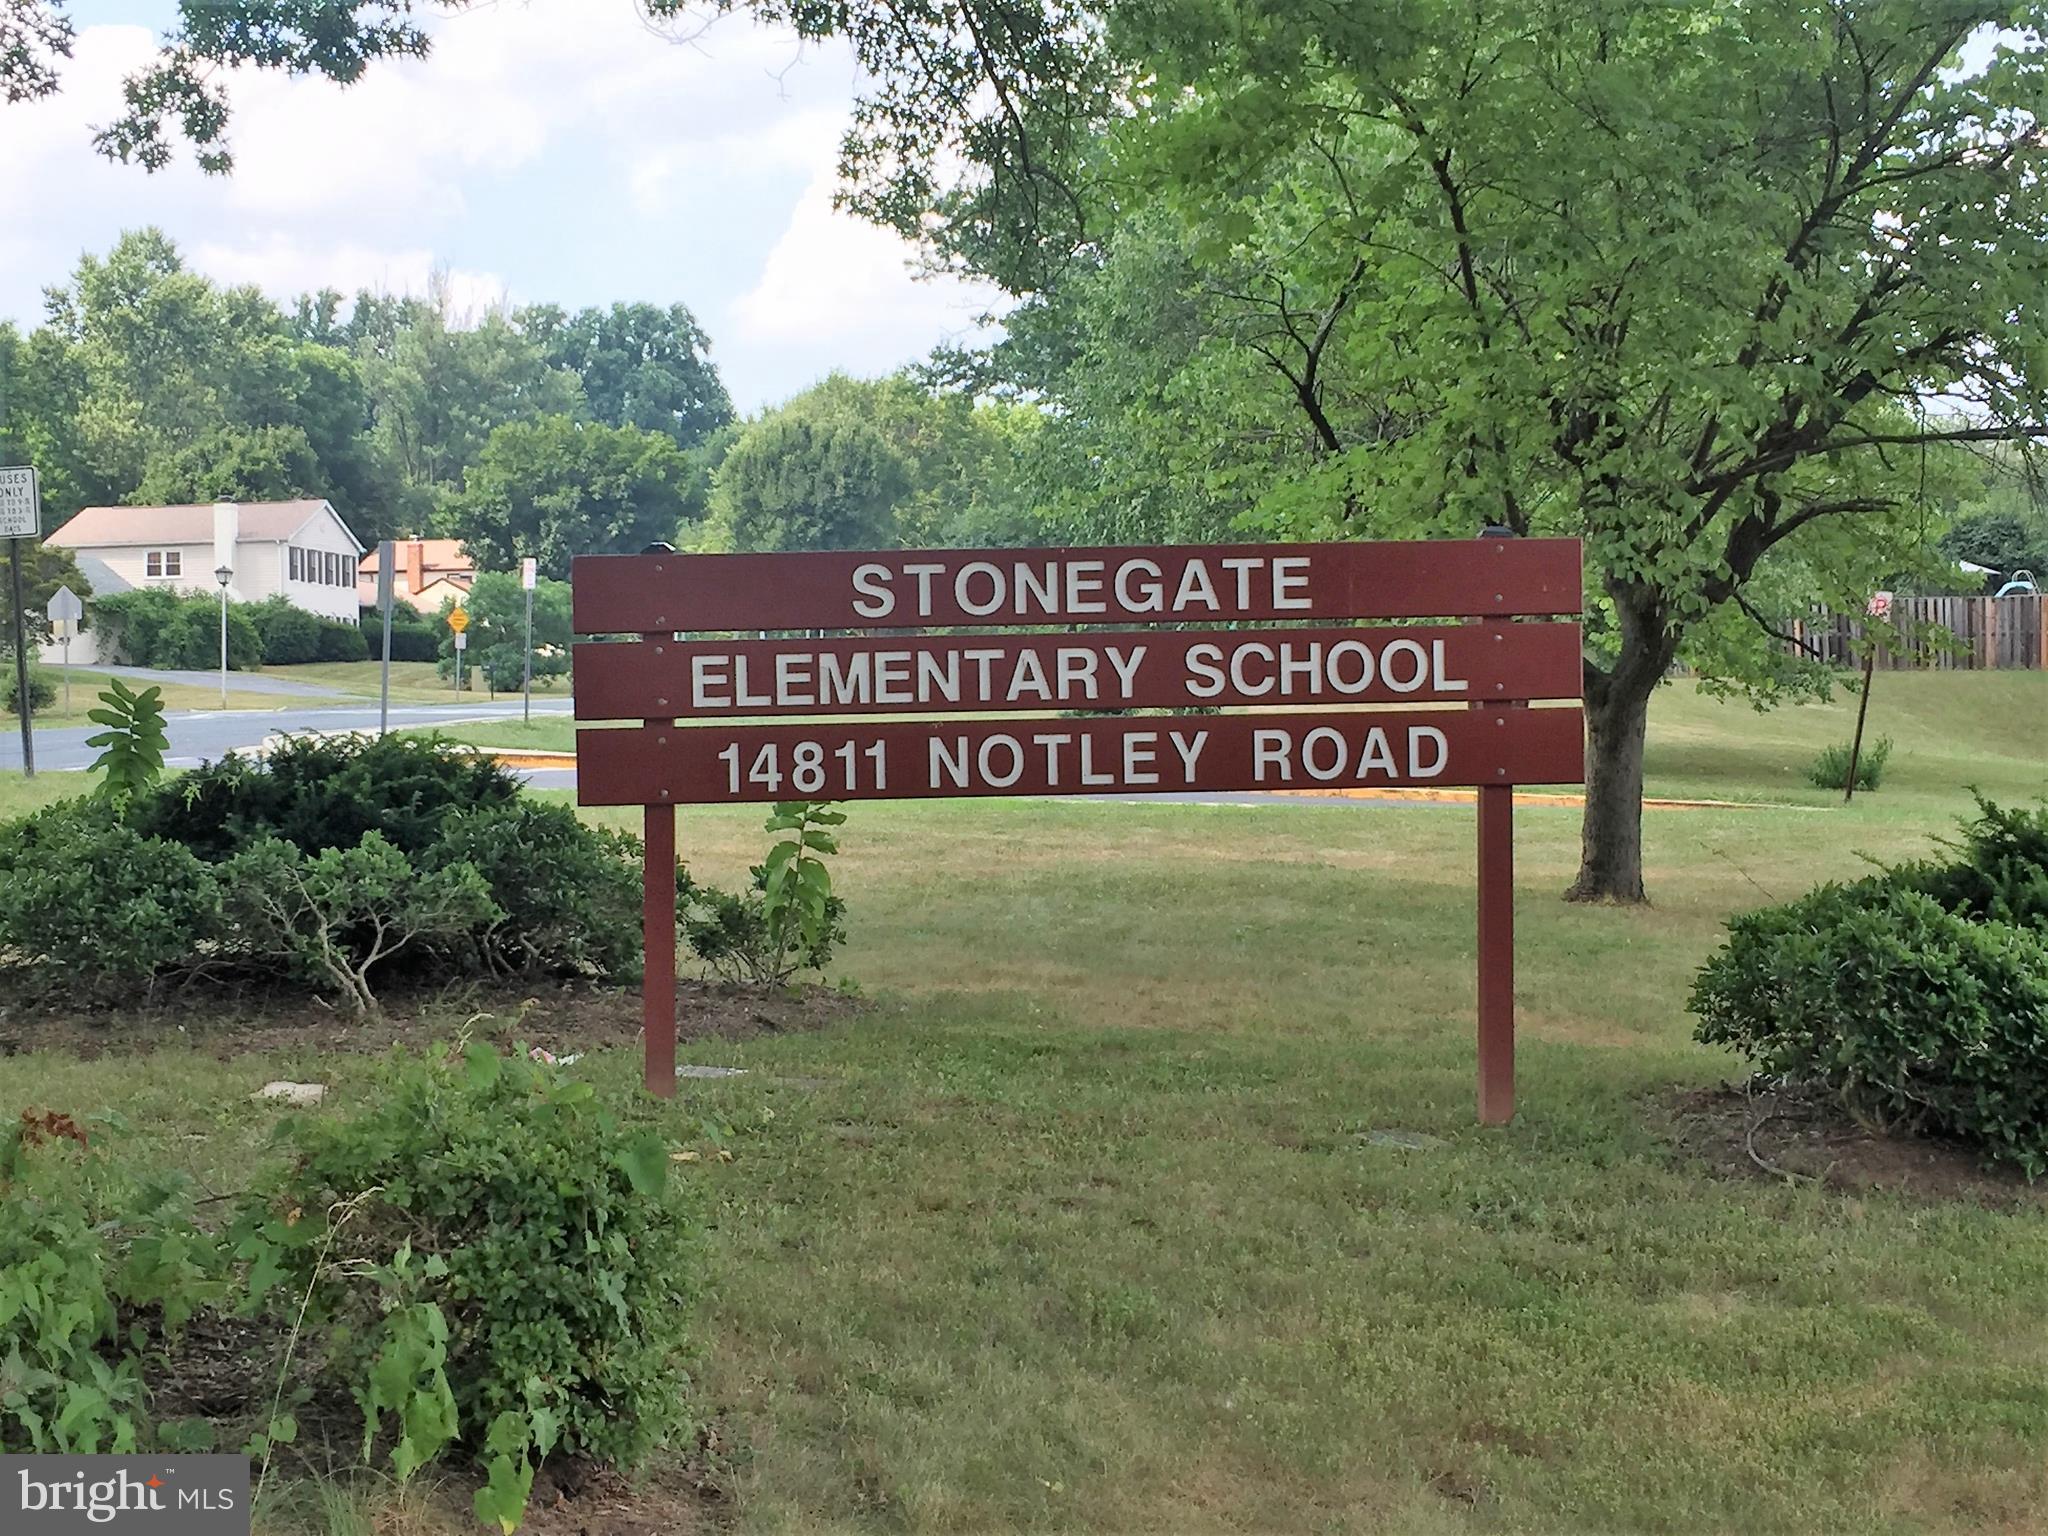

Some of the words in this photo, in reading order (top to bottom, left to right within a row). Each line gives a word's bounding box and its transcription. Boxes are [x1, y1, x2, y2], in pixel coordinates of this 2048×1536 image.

[851, 557, 1313, 620] STONEGATE
[691, 645, 1148, 709] ELEMENTARY
[1184, 639, 1469, 698] SCHOOL
[718, 740, 888, 795] 14811
[928, 730, 1209, 790] NOTLEY
[1252, 726, 1449, 782] ROAD
